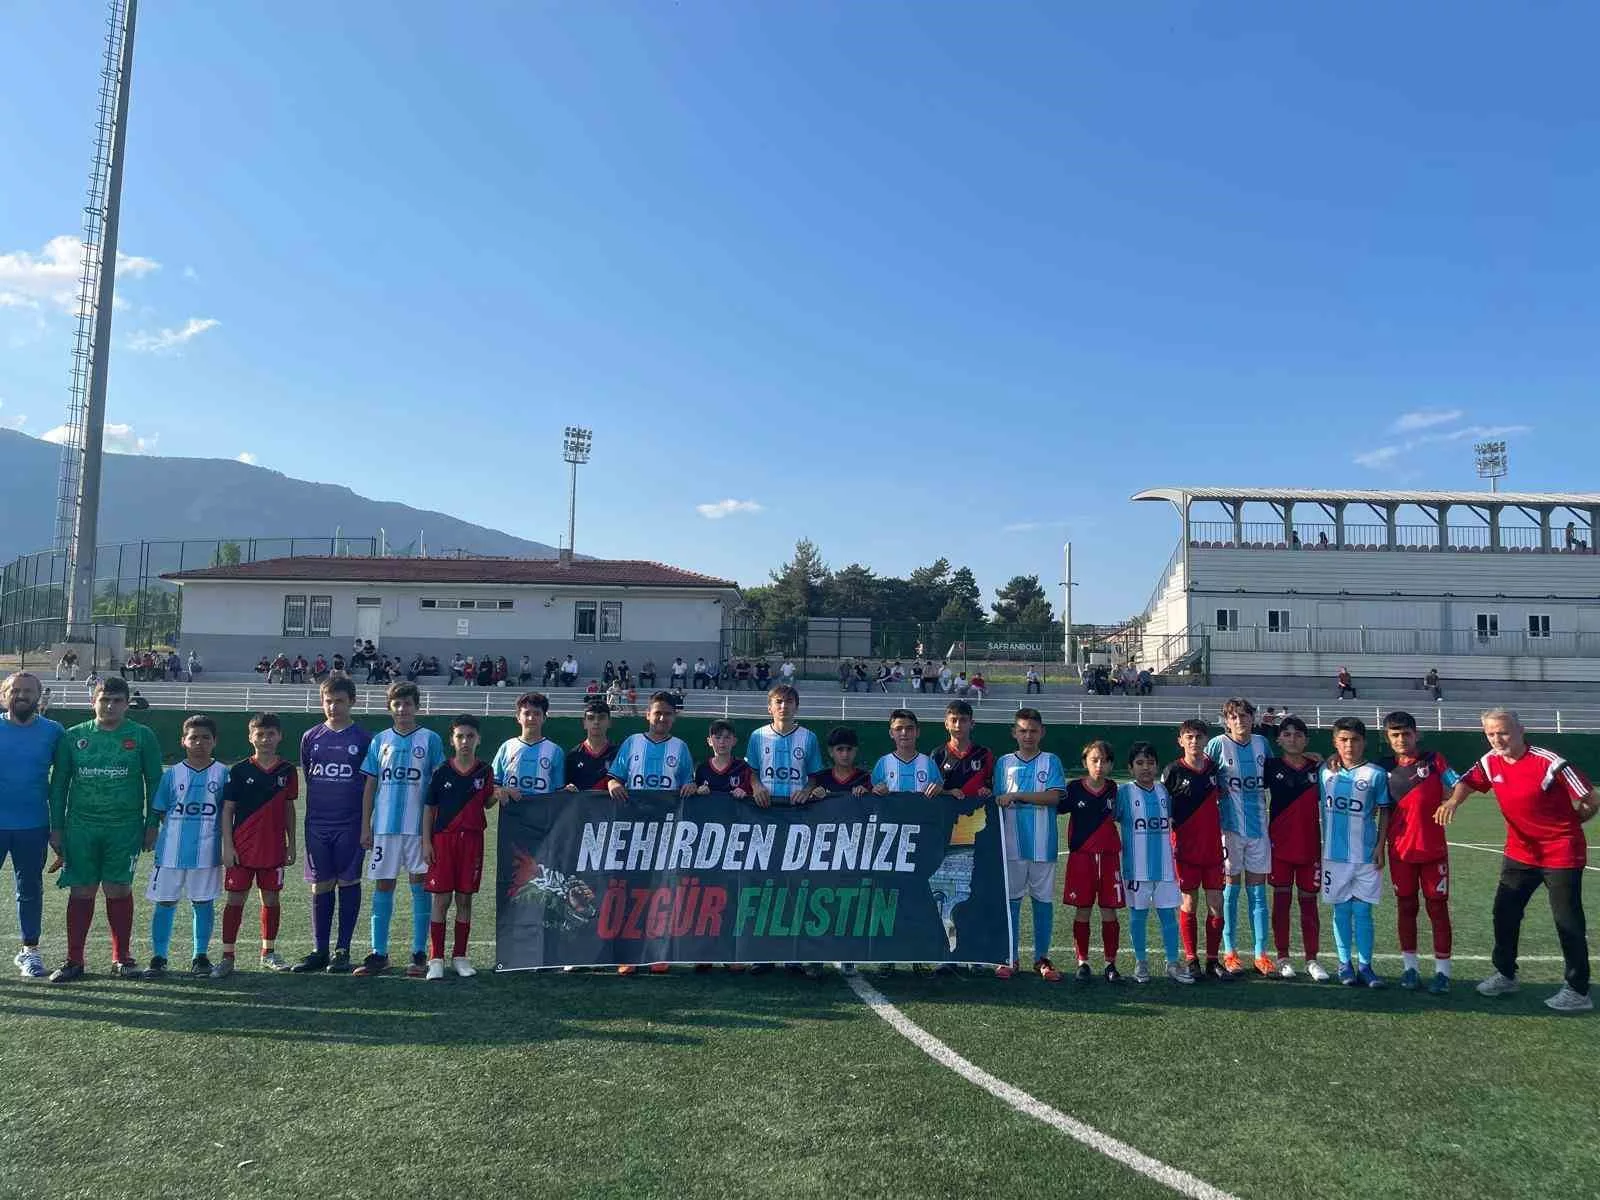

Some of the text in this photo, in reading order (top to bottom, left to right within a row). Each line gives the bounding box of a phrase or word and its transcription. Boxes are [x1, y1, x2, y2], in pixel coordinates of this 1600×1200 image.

[312, 763, 353, 777] AGD
[382, 767, 421, 781] AGD
[765, 766, 801, 781] AGD
[508, 776, 547, 790] AGD
[633, 774, 672, 788] AGD
[172, 802, 217, 816] AGD
[1326, 795, 1363, 812] AGD
[1134, 816, 1169, 830] AGD
[576, 813, 921, 873] NEHİRDEN DENİZE
[374, 846, 383, 862] 3
[1324, 870, 1332, 886] 5
[1436, 876, 1448, 895] 4
[595, 876, 899, 940] ÖZGÜR FİLİSTİN
